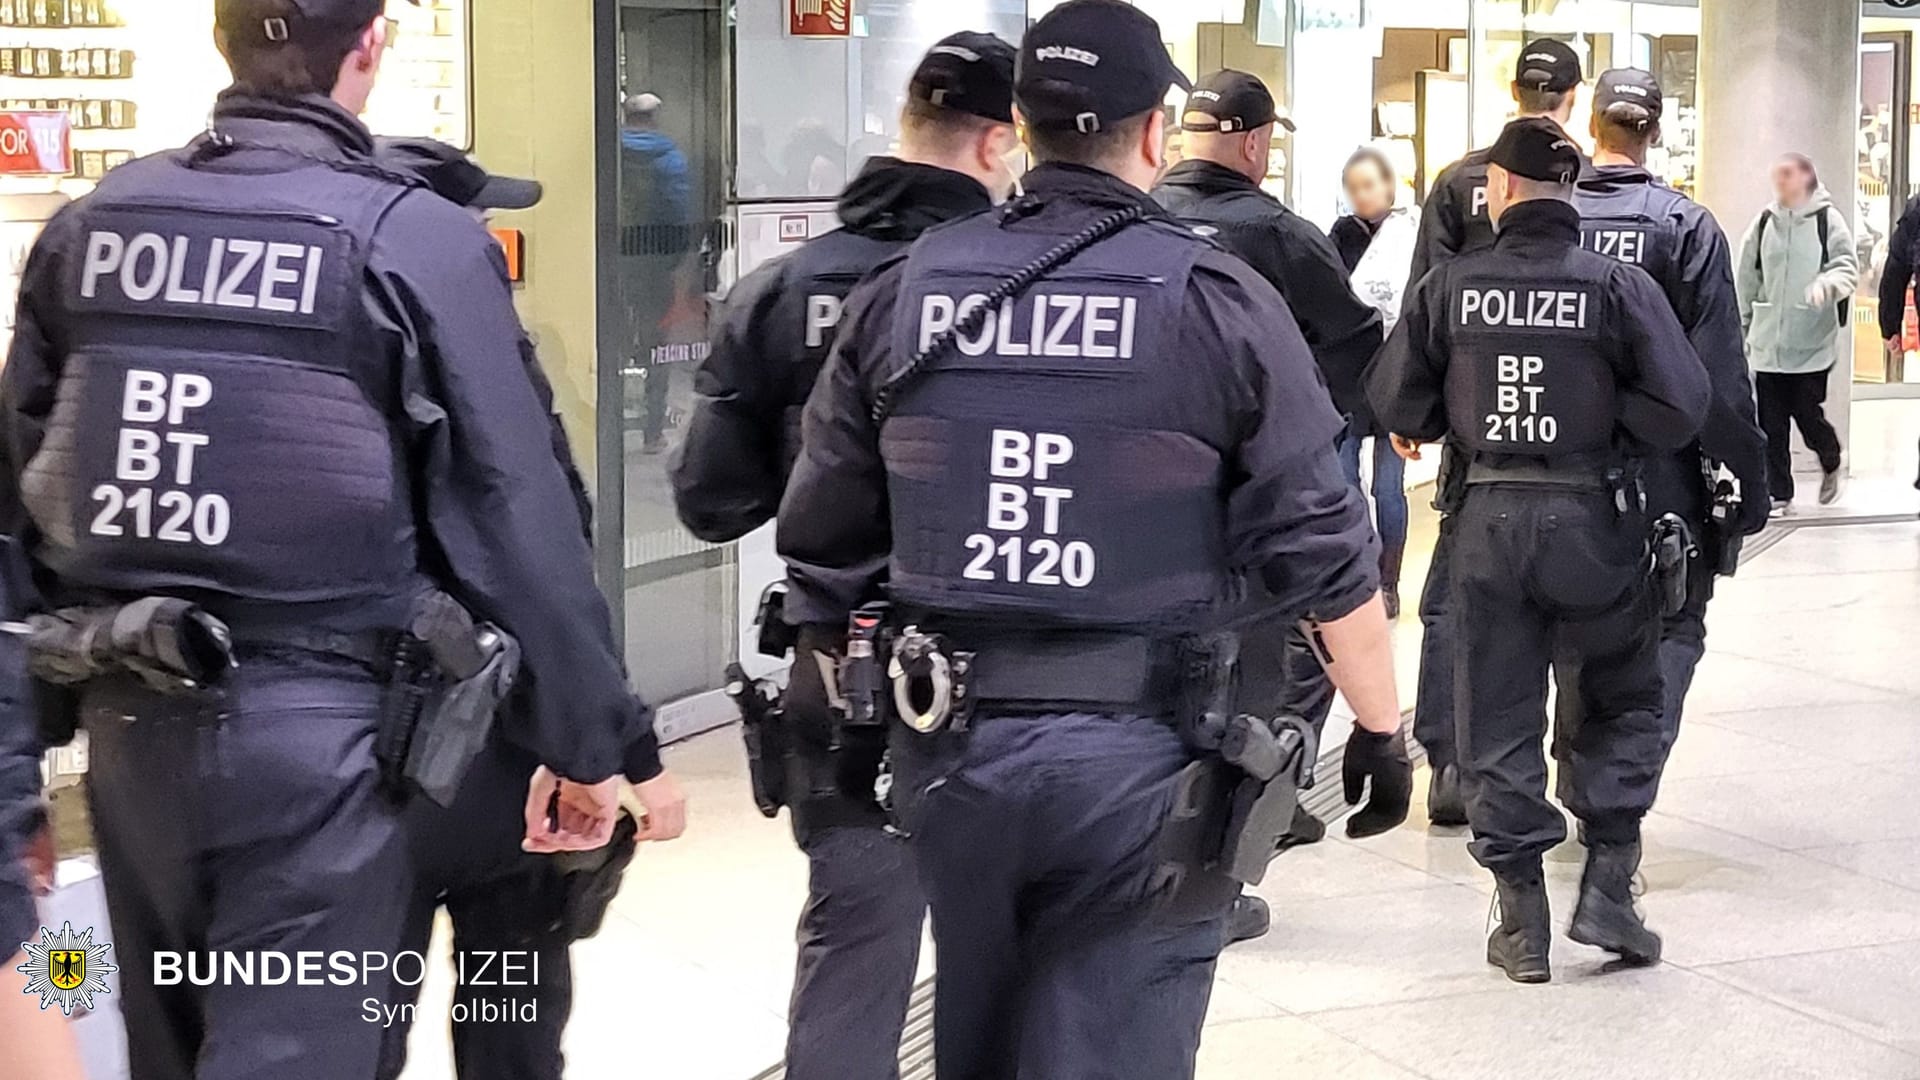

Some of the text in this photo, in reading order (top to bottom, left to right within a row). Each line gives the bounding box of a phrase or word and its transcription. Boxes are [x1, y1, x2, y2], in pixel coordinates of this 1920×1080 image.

[1035, 46, 1100, 67] POLIZEI
[81, 231, 322, 314] POLIZEI
[919, 293, 1137, 360] POLIZEI
[1460, 289, 1586, 329] POLIZEI
[1498, 355, 1544, 383] BP
[122, 369, 213, 425] BP
[1498, 385, 1545, 414] BT
[990, 429, 1074, 480] BP
[1485, 414, 1557, 443] 2110
[116, 427, 210, 485] BT
[90, 484, 230, 546] 2120
[987, 482, 1073, 535] BT
[962, 533, 1095, 588] 2120
